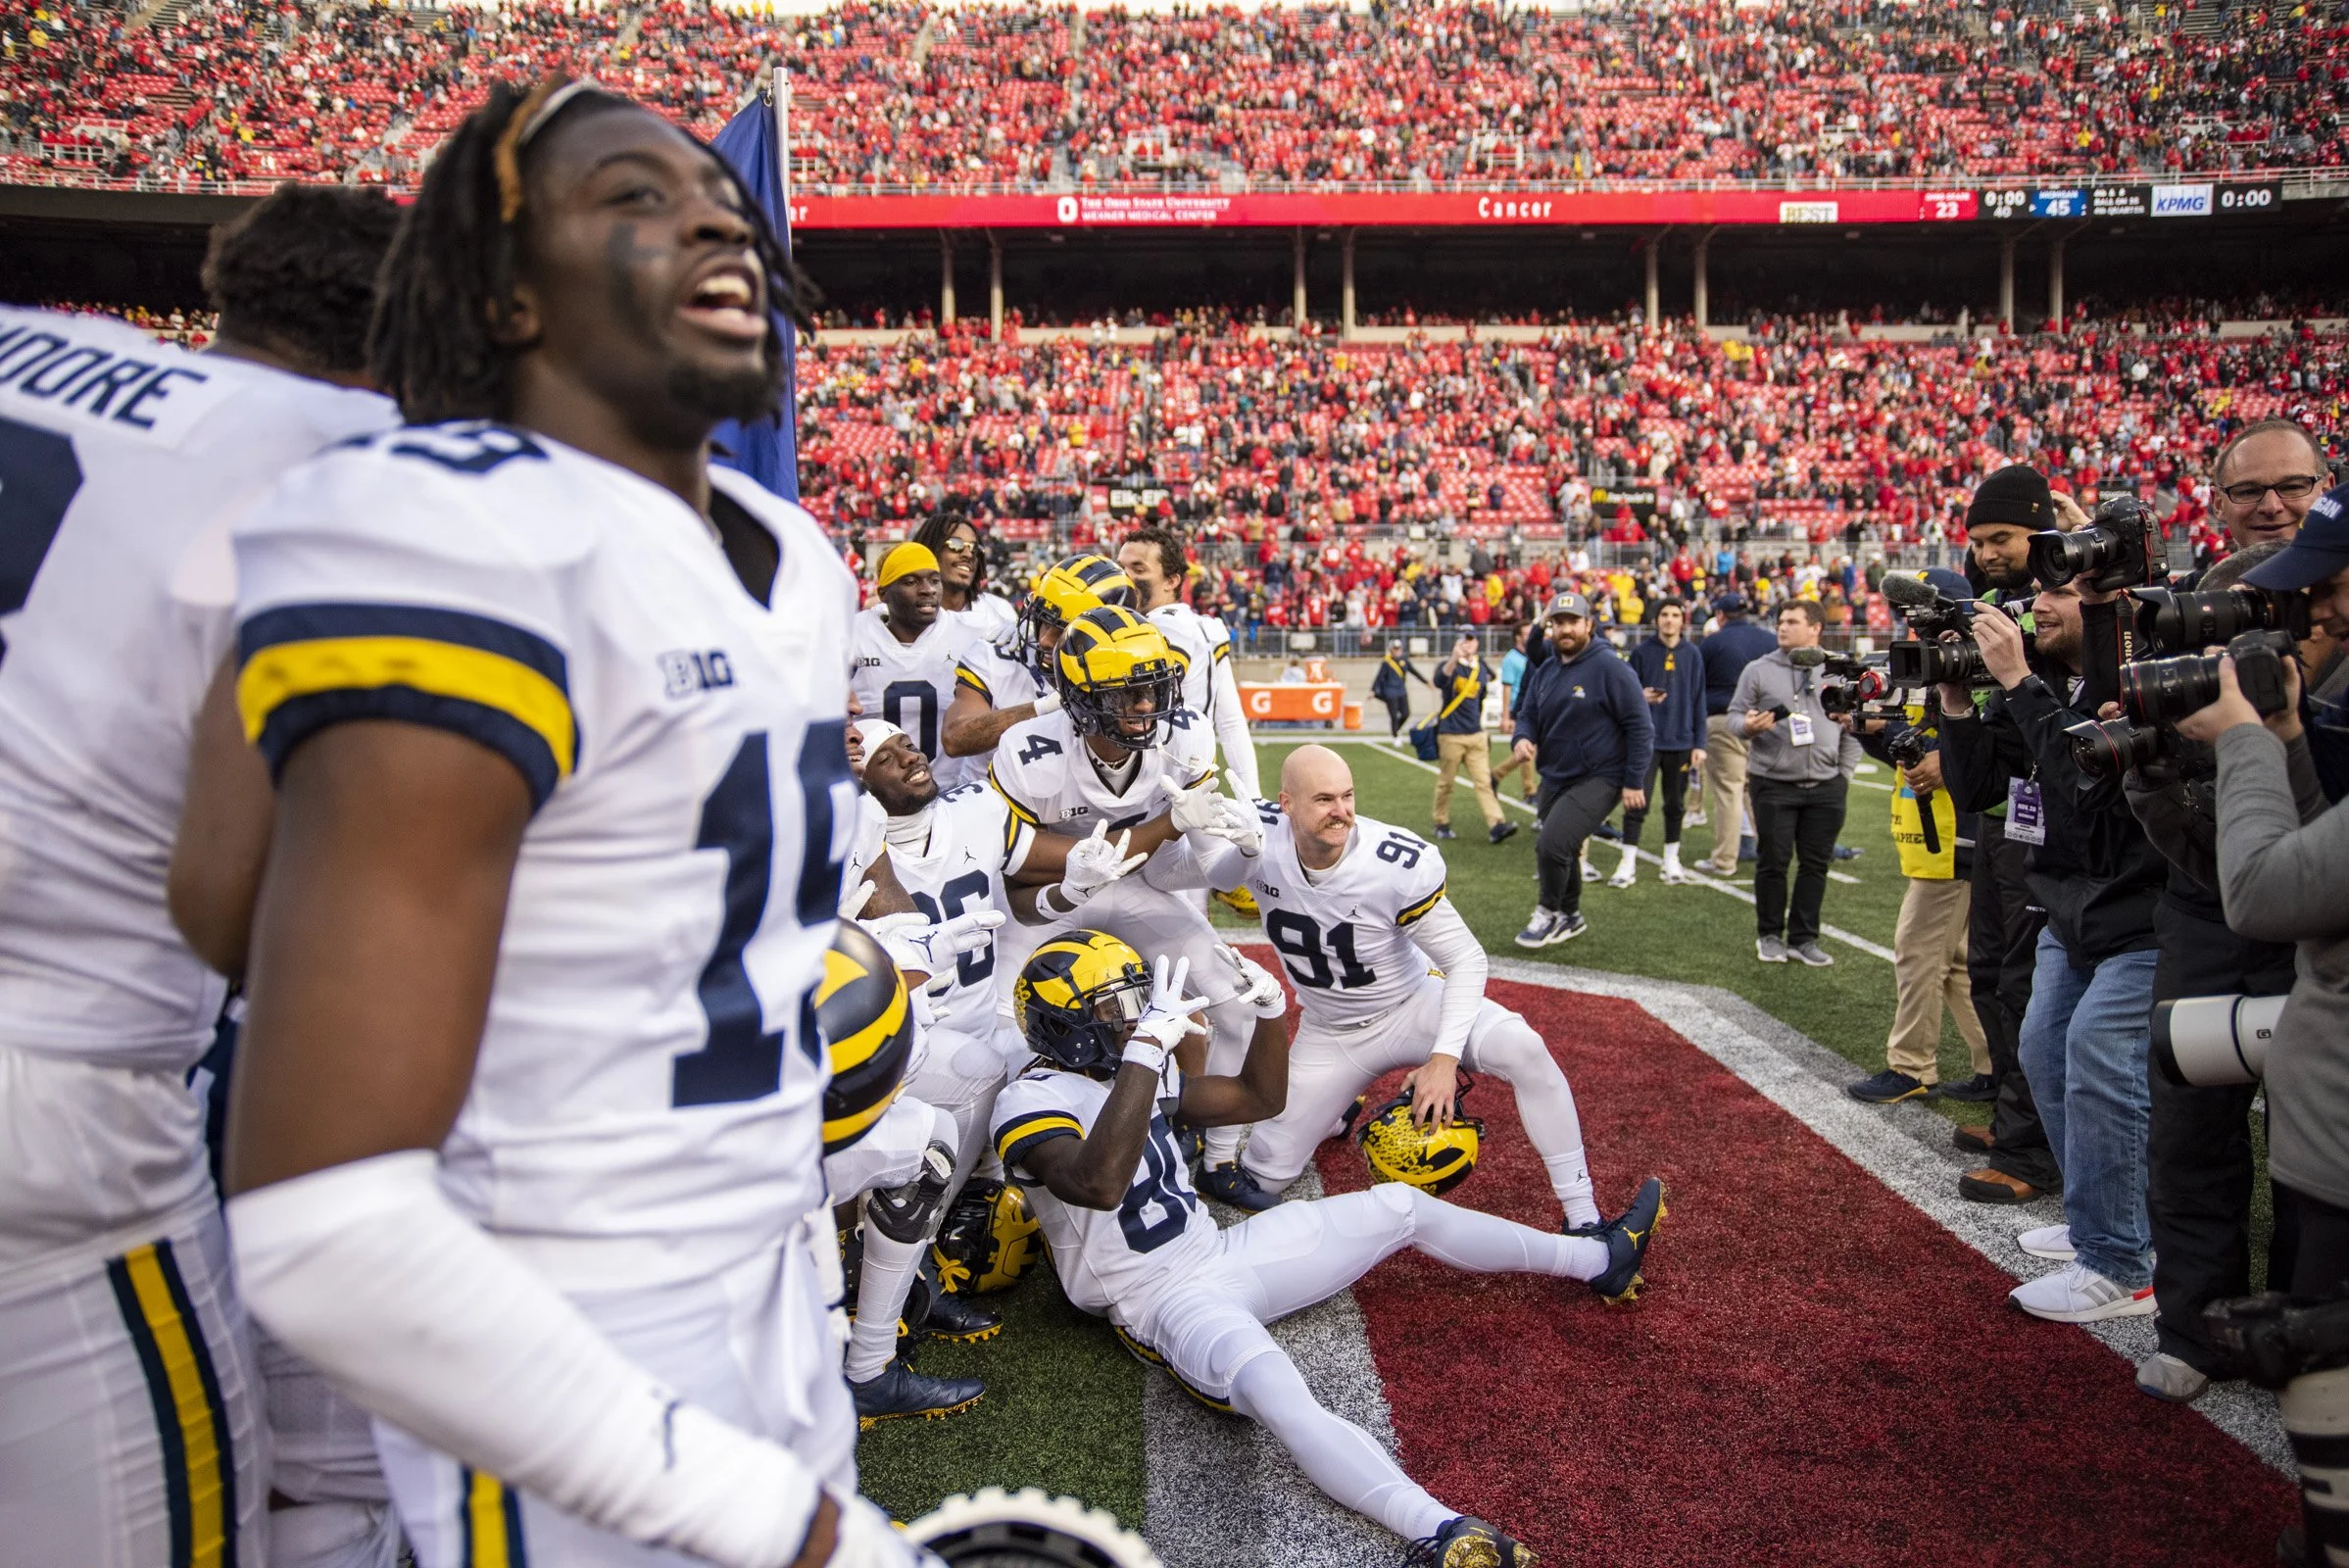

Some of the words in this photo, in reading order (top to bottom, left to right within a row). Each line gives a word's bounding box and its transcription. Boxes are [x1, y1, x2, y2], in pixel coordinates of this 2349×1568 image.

[1478, 196, 1552, 219] Cancer
[1984, 190, 2026, 207] 0:00
[2045, 199, 2071, 217] 45
[2156, 197, 2204, 212] KPMG
[2222, 189, 2273, 208] 0:00
[1935, 202, 1959, 219] 23
[0, 325, 209, 428] OORE
[1251, 691, 1271, 714] G
[1312, 691, 1333, 714] G
[883, 680, 938, 763] 0
[1018, 734, 1063, 765] 4
[1376, 831, 1428, 869] 91
[1267, 907, 1377, 990] 91
